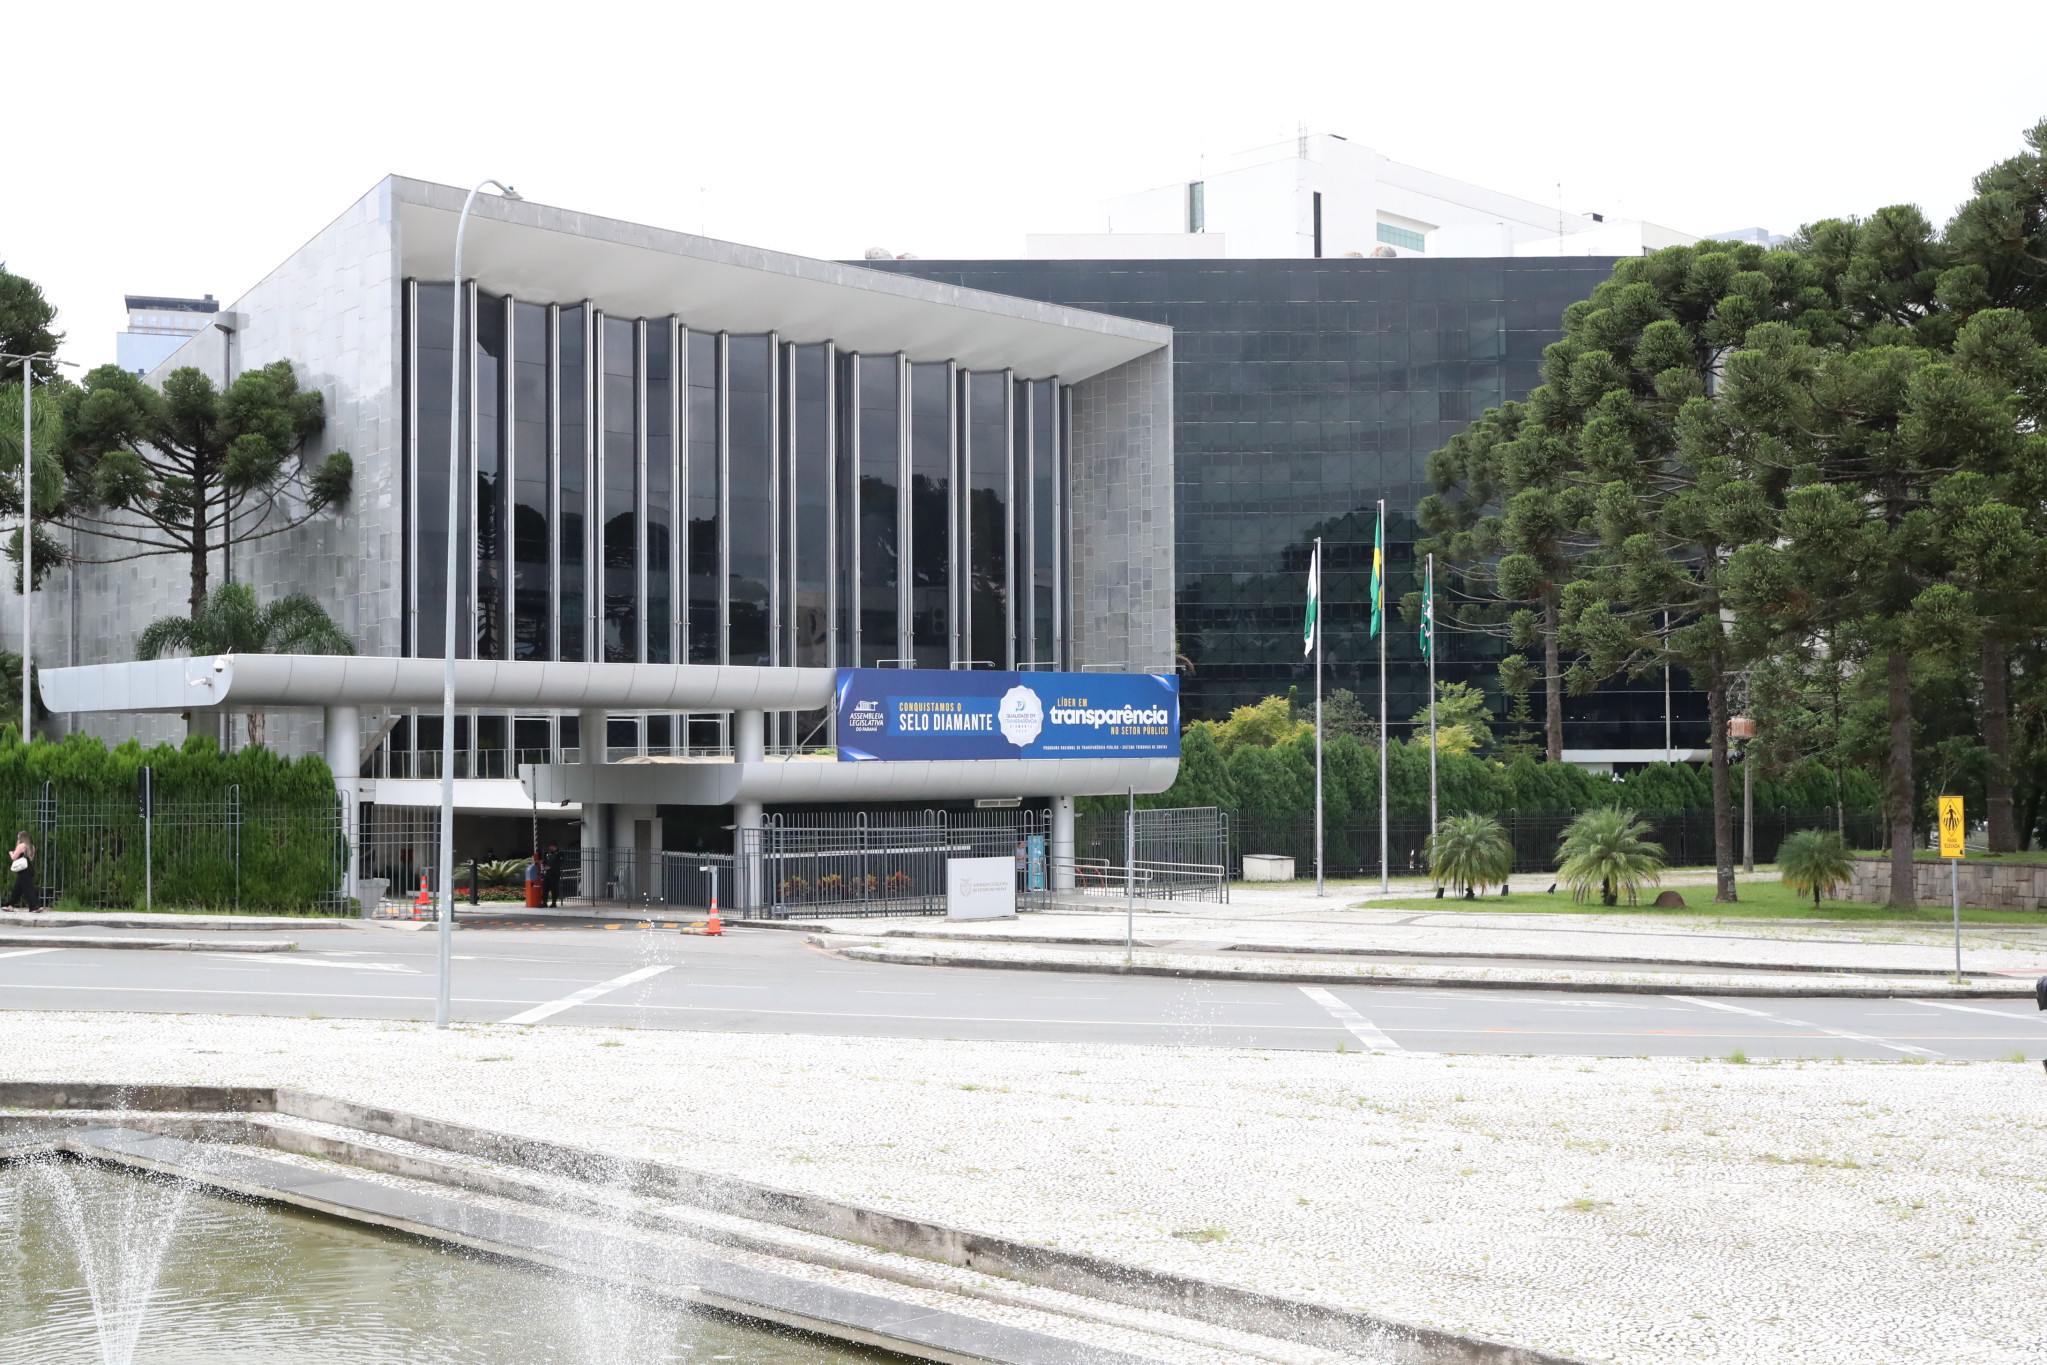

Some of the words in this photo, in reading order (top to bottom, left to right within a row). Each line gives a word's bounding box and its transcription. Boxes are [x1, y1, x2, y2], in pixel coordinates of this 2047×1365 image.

[1057, 696, 1076, 707] LÍDER
[1078, 698, 1088, 707] EM
[899, 702, 955, 712] CONQUISTAMOS
[957, 702, 962, 712] O
[849, 712, 884, 720] ASSEMBLEIA
[1049, 704, 1168, 729] transparência
[849, 719, 884, 727] LEGISLATIVA
[899, 713, 929, 731] SELO
[933, 713, 993, 731] DIAMANTE
[1110, 726, 1119, 735] NO
[1121, 726, 1141, 735] SETOR
[1143, 725, 1169, 735] PÚBLICO
